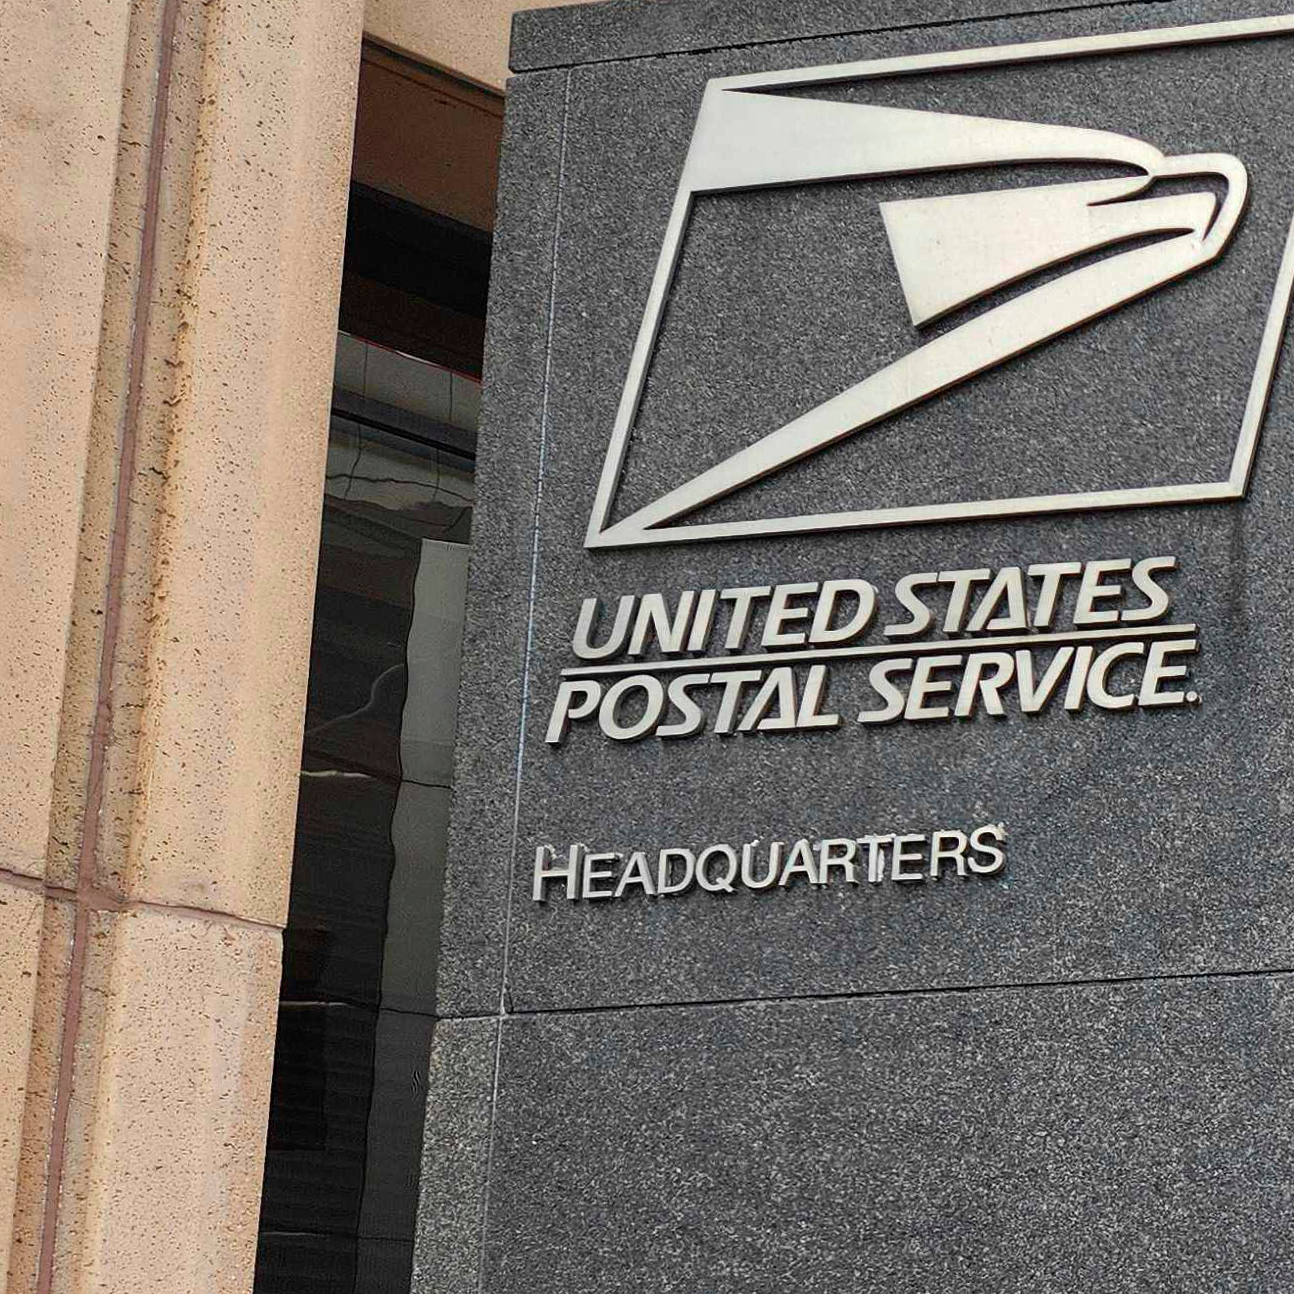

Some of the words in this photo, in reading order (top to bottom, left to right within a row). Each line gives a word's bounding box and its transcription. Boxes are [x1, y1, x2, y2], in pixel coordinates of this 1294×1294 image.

[572, 578, 877, 660] UNITED
[883, 556, 1179, 636] STATES
[545, 664, 842, 744] POSTAL
[532, 823, 1005, 902] HEADQUARTERS
